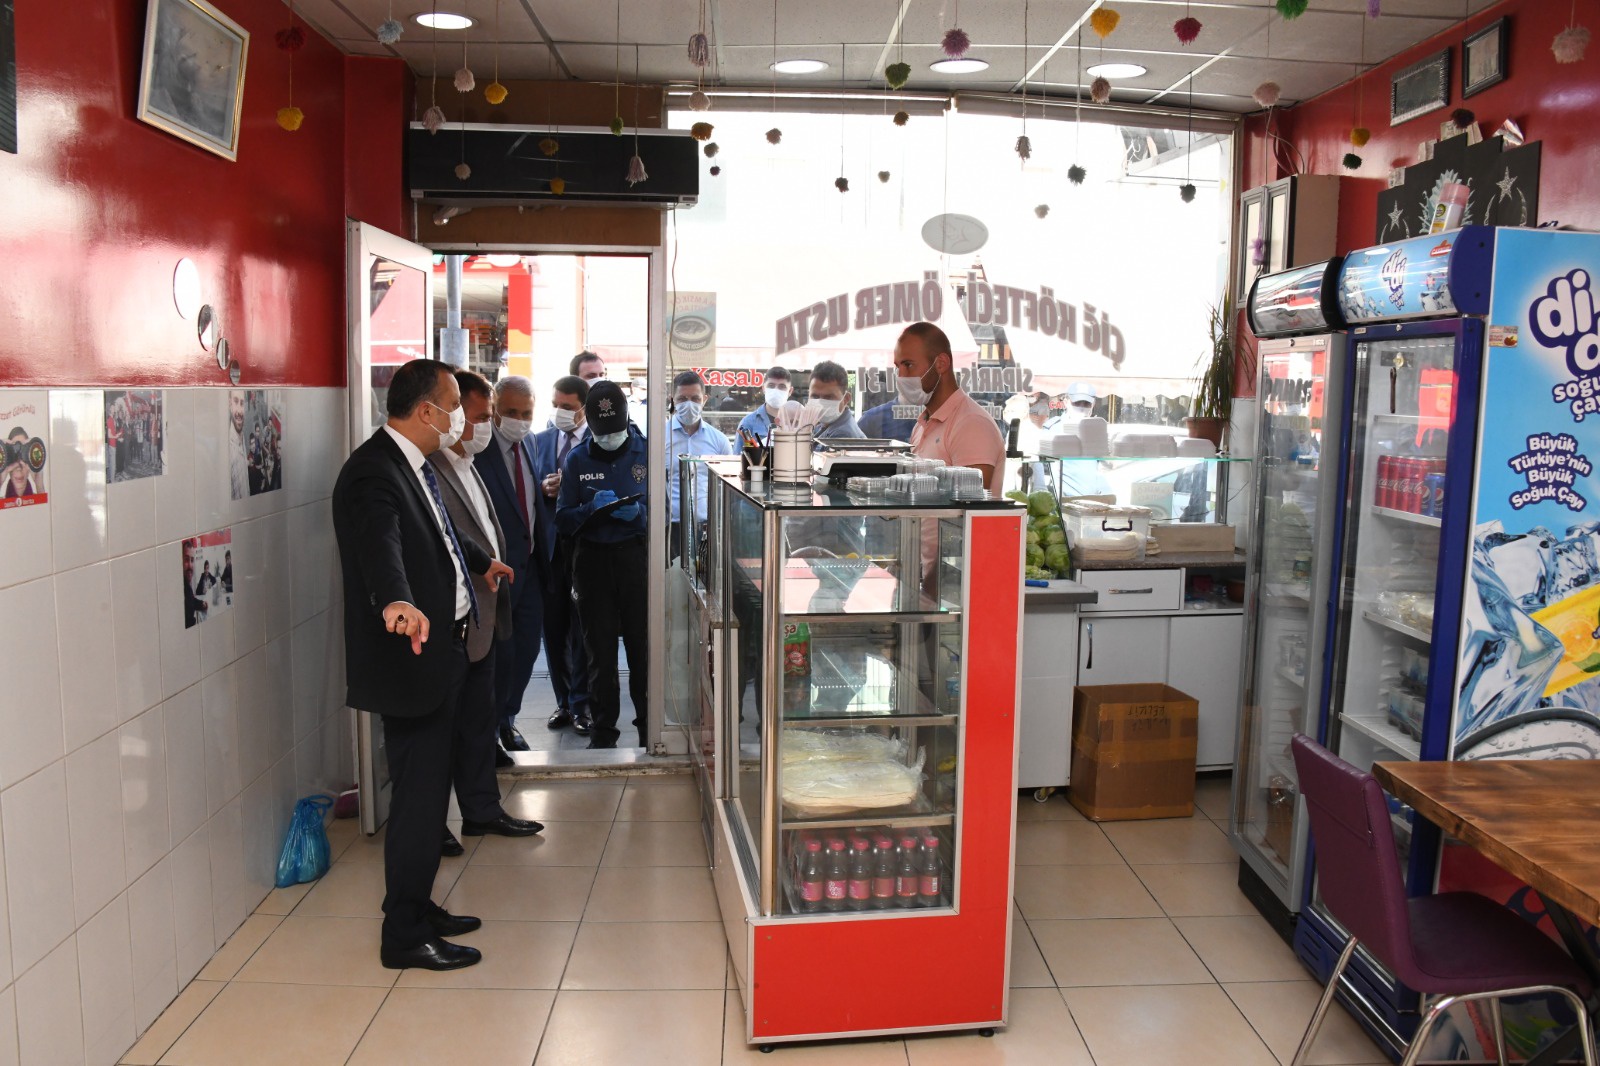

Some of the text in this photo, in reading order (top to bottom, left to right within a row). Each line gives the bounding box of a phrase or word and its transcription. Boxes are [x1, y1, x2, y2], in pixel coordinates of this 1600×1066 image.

[1533, 268, 1592, 342] di
[691, 367, 766, 388] Kasab
[1528, 435, 1577, 453] Büyük
[1510, 450, 1591, 475] Türkiye'nin
[1527, 467, 1575, 484] Büyük
[1511, 484, 1585, 509] Soğuk Çayı
